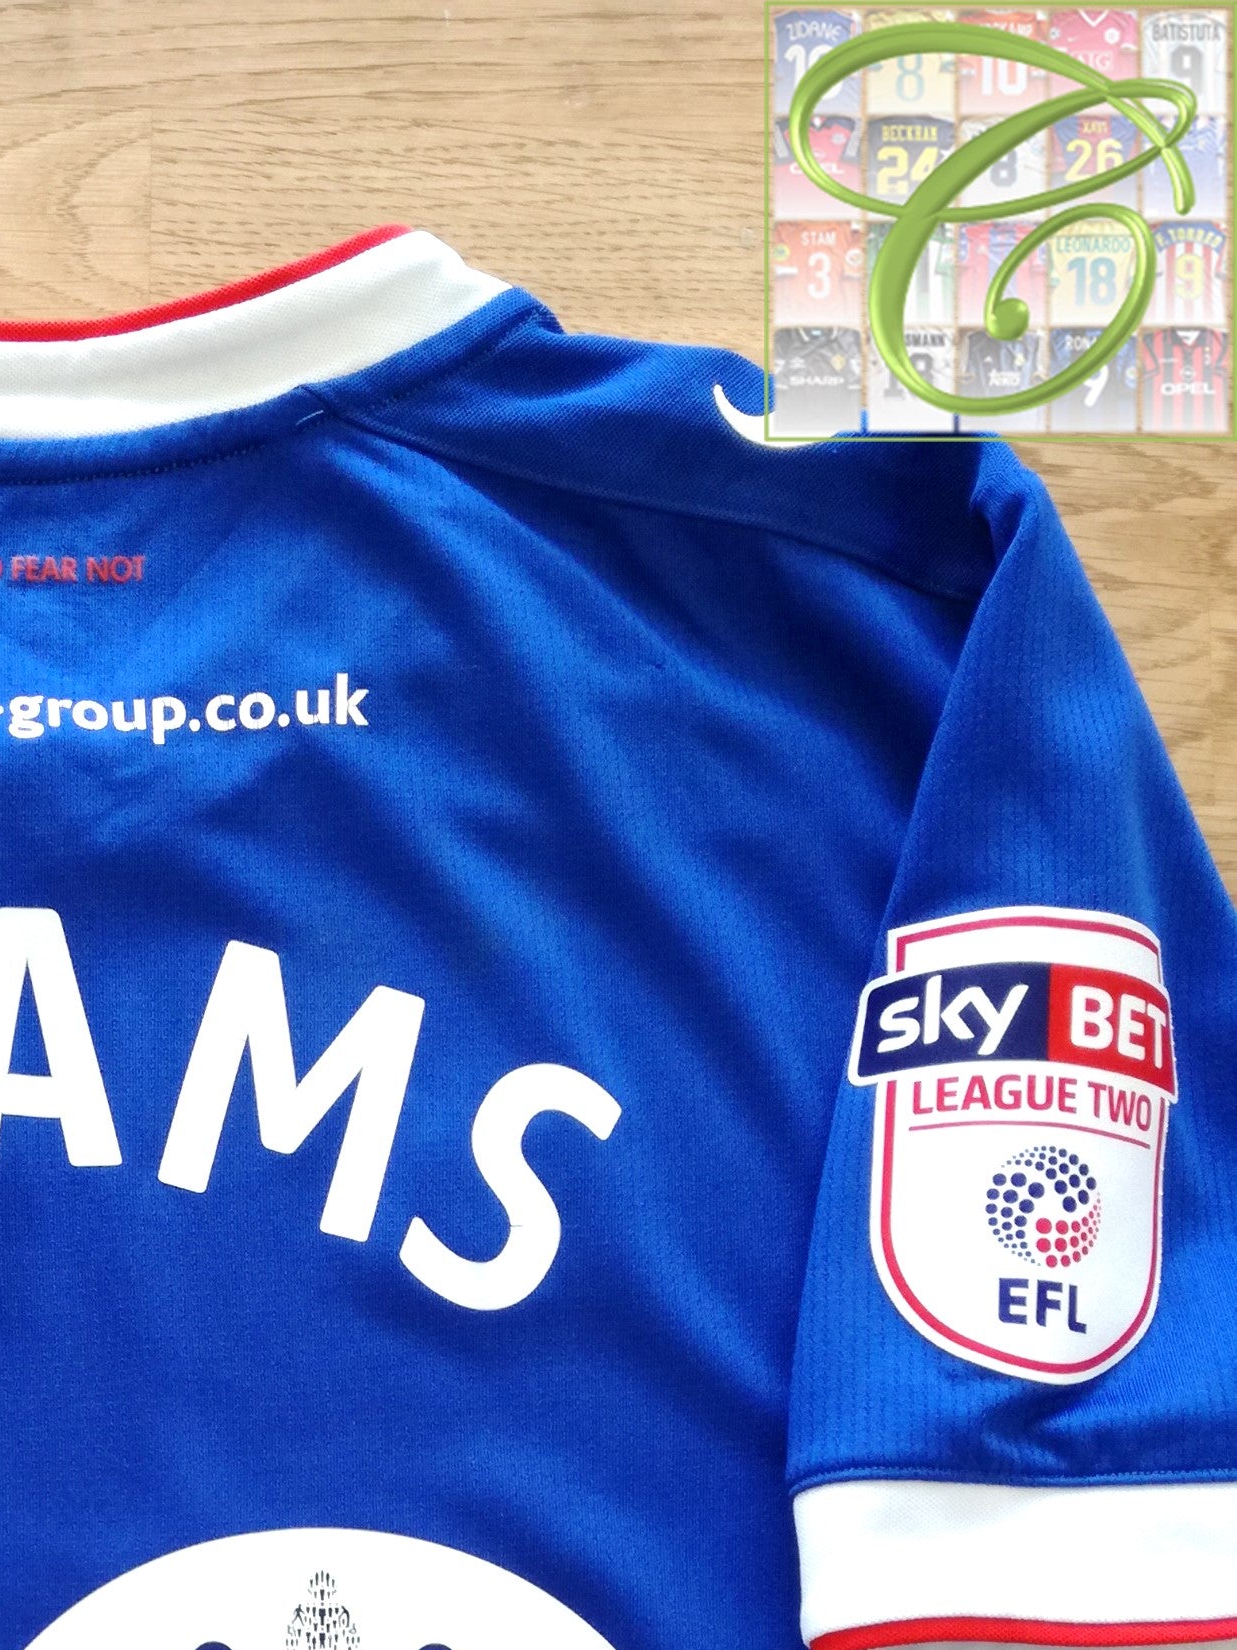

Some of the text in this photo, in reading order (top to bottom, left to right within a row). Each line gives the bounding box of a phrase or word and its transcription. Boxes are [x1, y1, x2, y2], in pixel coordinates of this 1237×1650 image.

[11, 553, 78, 582] FEAR
[86, 554, 147, 583] NOT
[876, 974, 1169, 1069] sky BET
[911, 1073, 1152, 1132] LEAGUE TWO
[998, 1277, 1087, 1335] EFL
